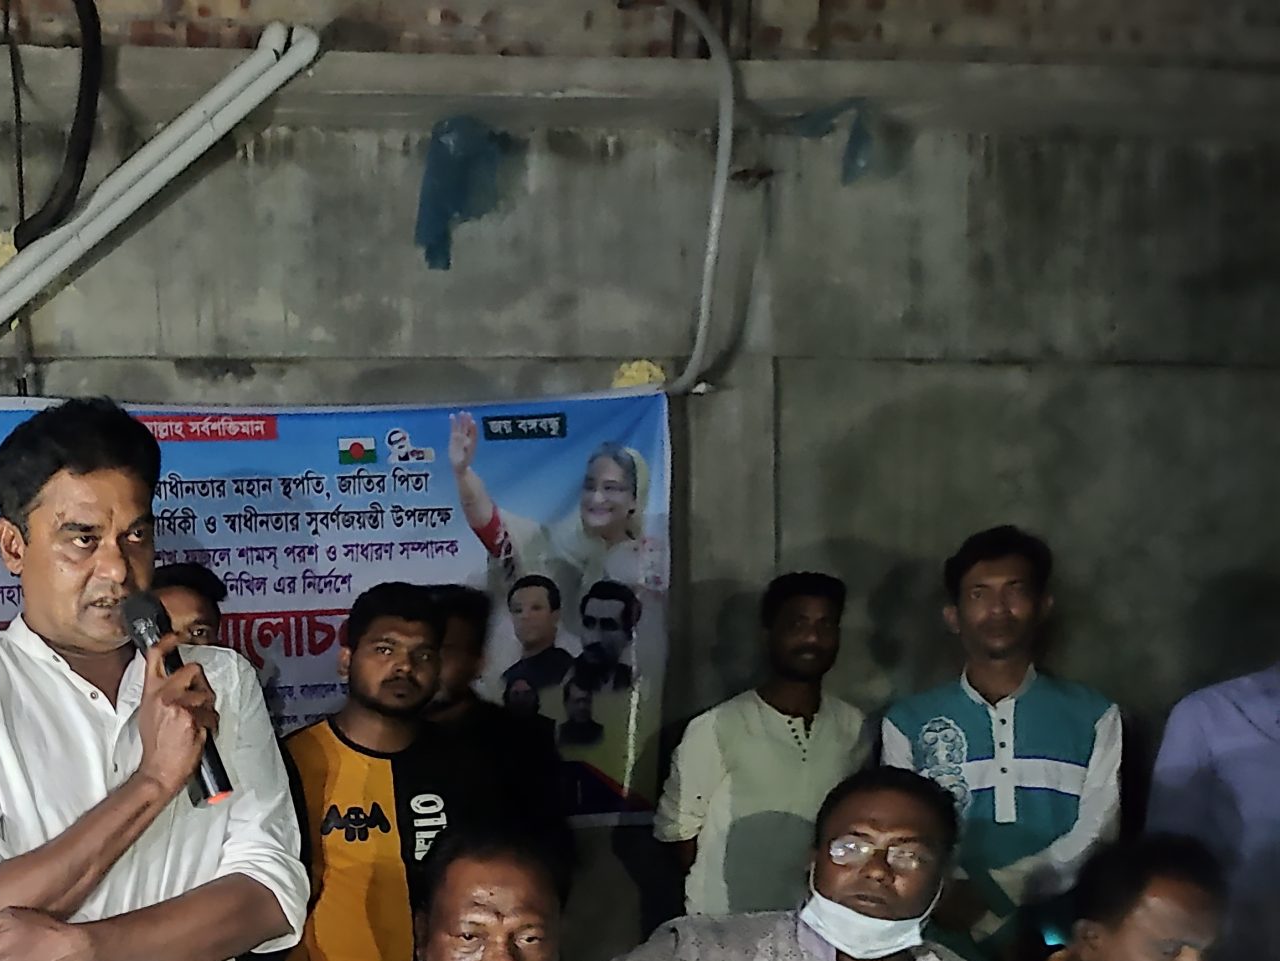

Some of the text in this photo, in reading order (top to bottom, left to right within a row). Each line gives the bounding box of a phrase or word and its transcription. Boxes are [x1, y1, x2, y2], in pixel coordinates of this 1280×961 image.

[231, 477, 272, 497] মহান
[336, 467, 387, 495] জাতির
[392, 466, 430, 492] পিতা
[204, 514, 218, 534] ও
[223, 506, 300, 534] স্বাধীনতার
[305, 501, 385, 536] সুবর্ণজয়ন্তী
[391, 504, 453, 528] উপলক্ষে
[283, 543, 319, 564] পরশ
[326, 545, 338, 562] ও
[342, 541, 394, 563] সাধারণ
[399, 539, 460, 560] সম্পাদক
[273, 576, 298, 595] এর
[302, 567, 352, 595] নির্দেশে
